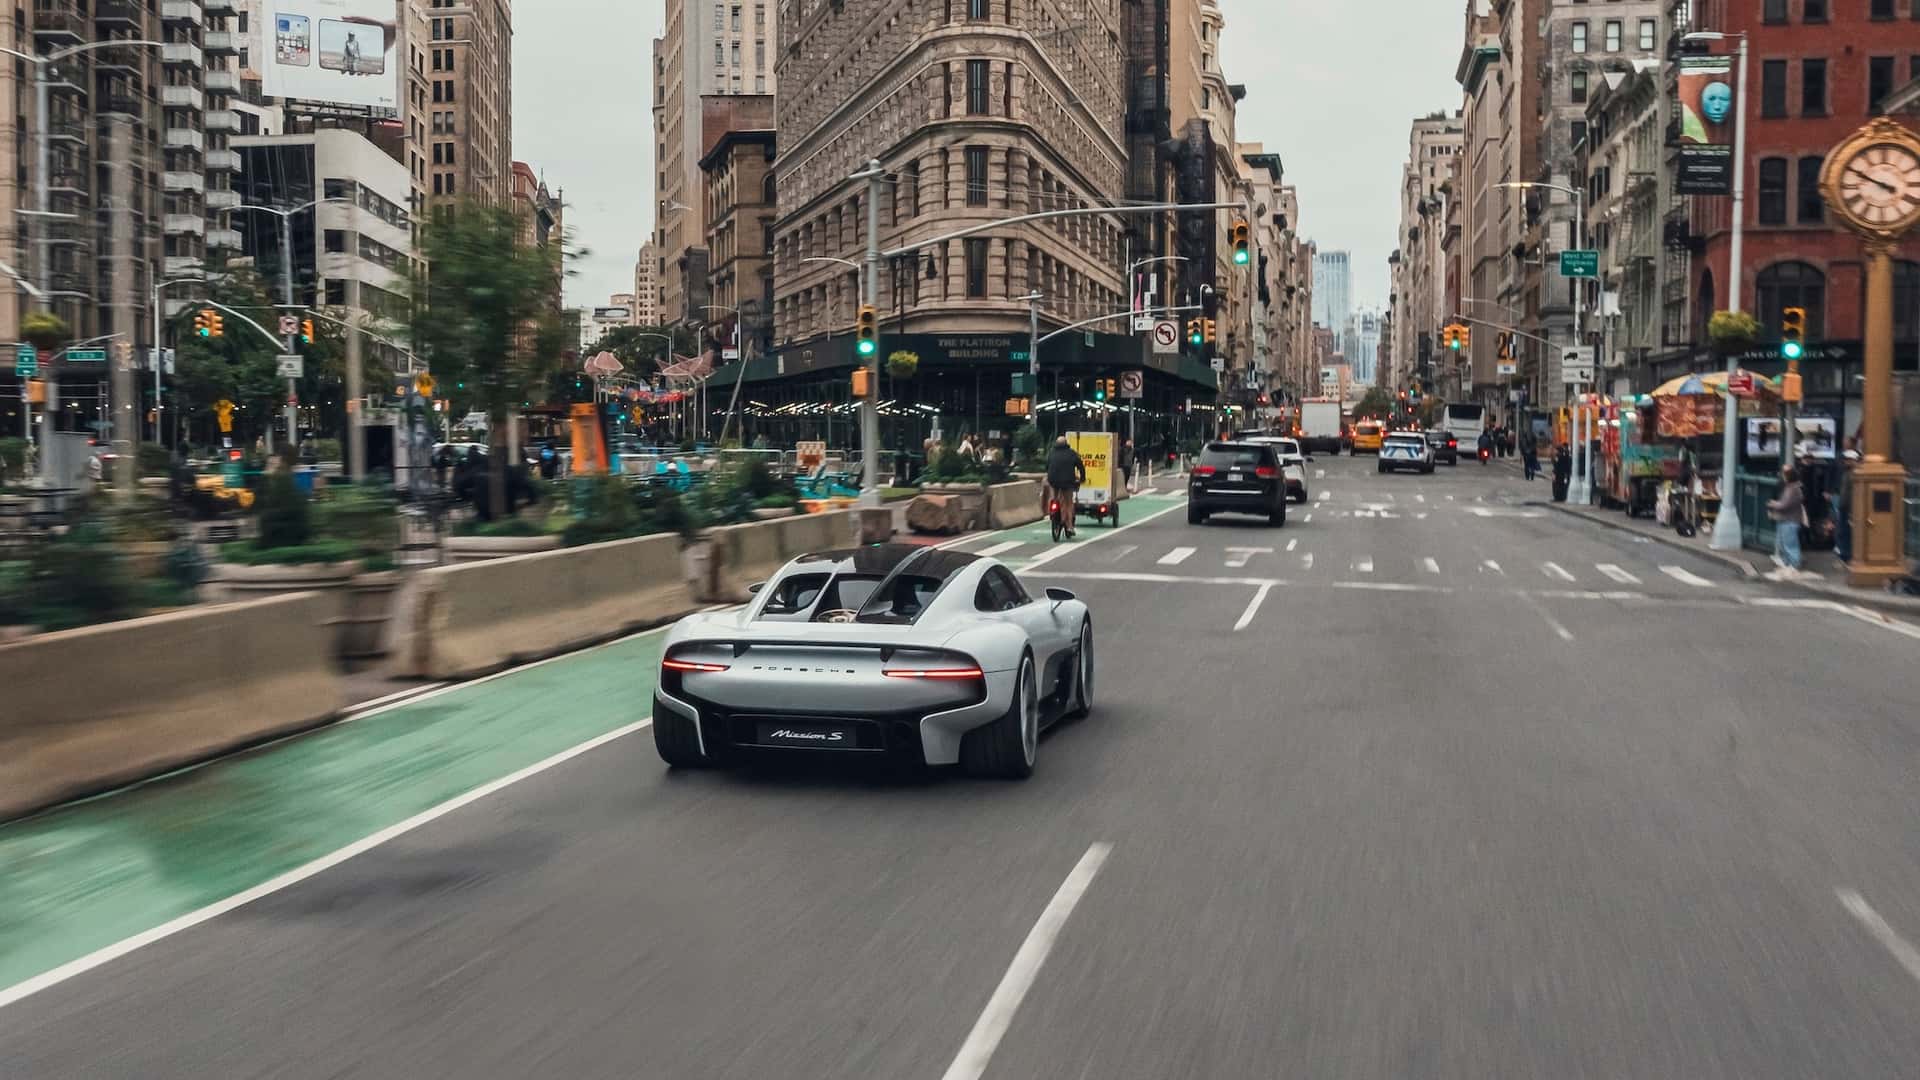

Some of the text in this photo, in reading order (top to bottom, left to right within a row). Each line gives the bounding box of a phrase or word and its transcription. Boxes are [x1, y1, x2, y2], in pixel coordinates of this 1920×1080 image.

[938, 338, 957, 347] THE
[948, 349, 999, 358] BUILDING
[1766, 351, 1778, 359] OF
[753, 666, 855, 674] PORSCHE
[770, 729, 843, 740] Mission S
